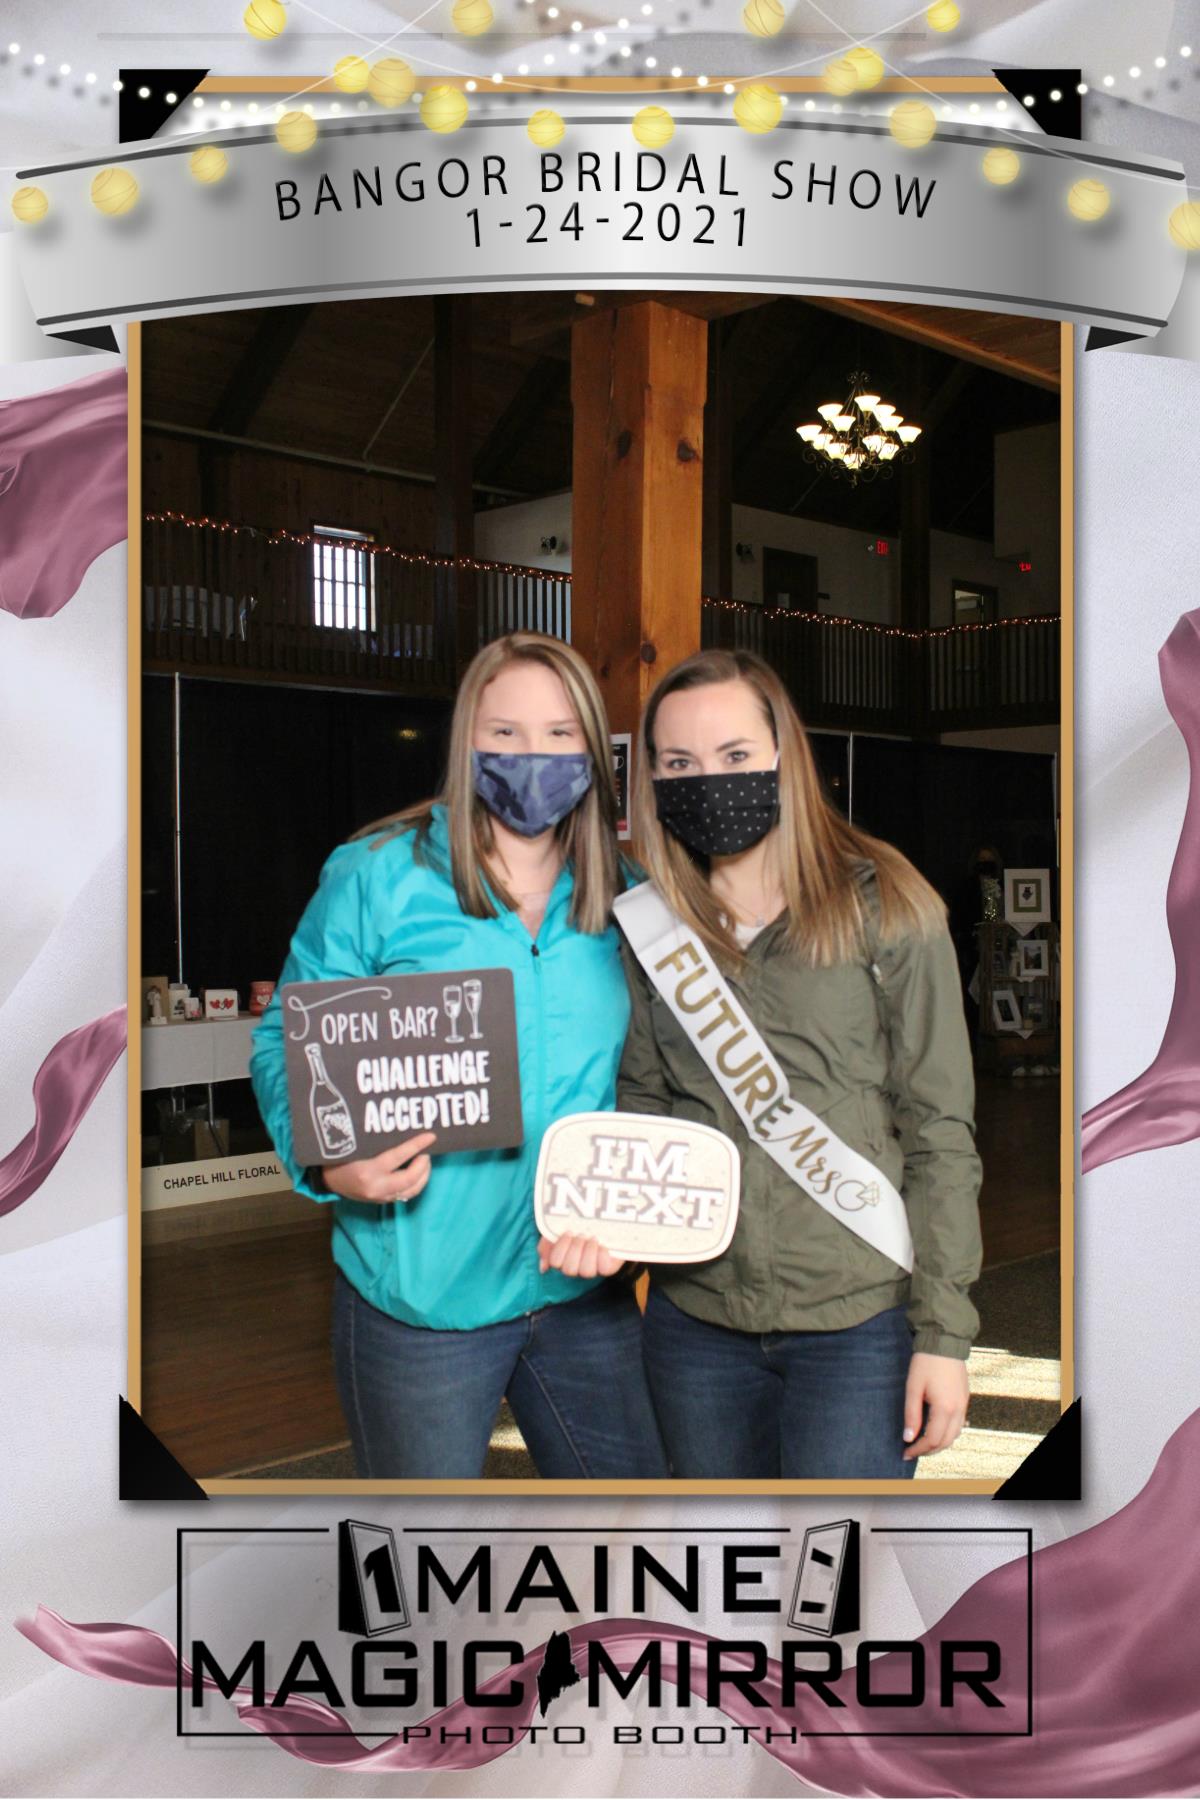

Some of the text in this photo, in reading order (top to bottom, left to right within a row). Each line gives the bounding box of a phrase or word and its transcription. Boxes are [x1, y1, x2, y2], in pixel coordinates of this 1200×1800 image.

[321, 1006, 439, 1045] OPEN BAR?
[356, 1050, 491, 1094] CHALLENGE
[654, 941, 842, 1195] FUTURE Mrs
[364, 1087, 491, 1133] ACCEPTED!
[163, 1164, 281, 1190] CHAPEL HILL FLORAL
[588, 1134, 690, 1183] I'M
[543, 1173, 725, 1229] NEXT
